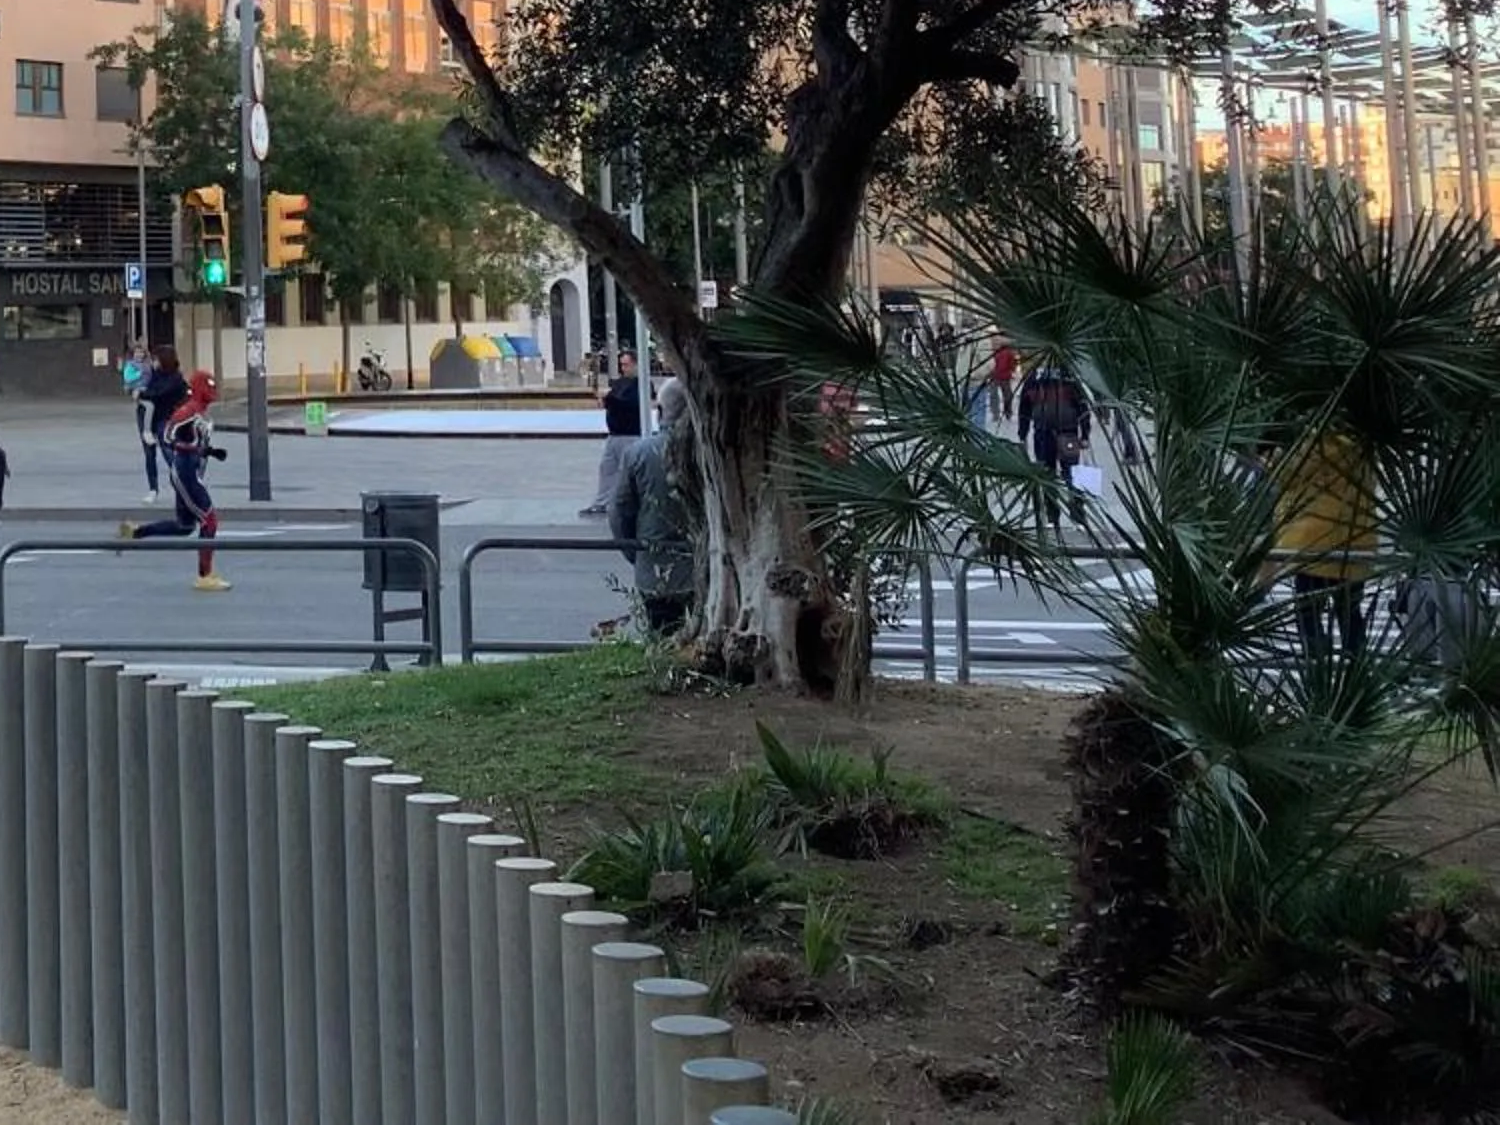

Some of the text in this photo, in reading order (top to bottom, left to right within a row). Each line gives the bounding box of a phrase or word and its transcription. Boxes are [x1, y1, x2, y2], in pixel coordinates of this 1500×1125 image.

[11, 272, 125, 295] HOSTAL SAN
[129, 266, 140, 288] P
